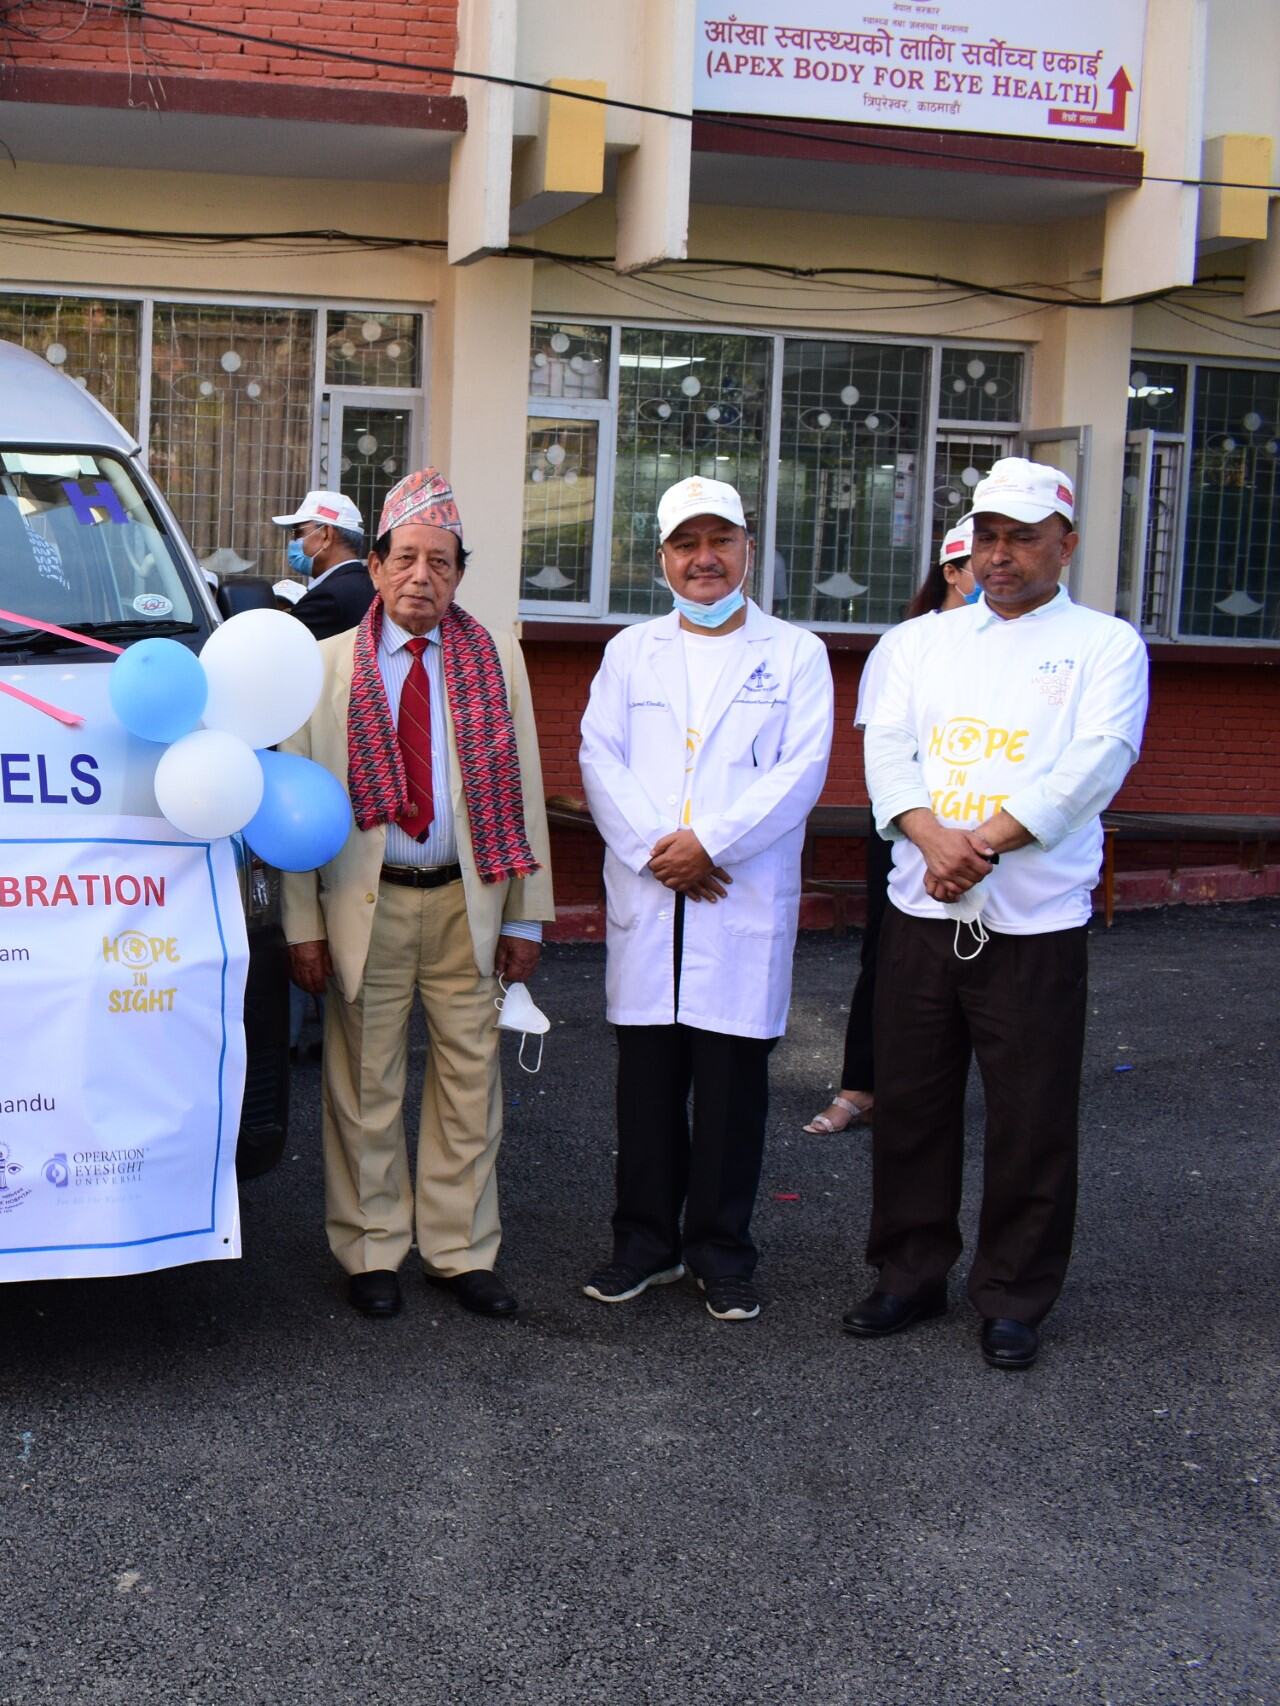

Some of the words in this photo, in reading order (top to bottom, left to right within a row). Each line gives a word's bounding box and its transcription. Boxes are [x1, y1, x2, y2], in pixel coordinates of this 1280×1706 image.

[705, 14, 768, 46] आँखा
[774, 27, 894, 57] स्वास्थ्यको
[900, 33, 955, 63] लागि
[961, 38, 1037, 70] सर्वोच्च
[1043, 49, 1103, 80] एकाई
[706, 50, 784, 79] (APEX
[793, 57, 864, 85] BODY
[873, 66, 925, 90] FOR
[934, 70, 982, 94] EYE
[992, 75, 1098, 111] HEALTH)
[946, 769, 967, 787] IN
[133, 972, 148, 987] IN
[108, 988, 178, 1013] SIGHT
[73, 1148, 145, 1164] OPERATION
[75, 1160, 145, 1177] EYESIGHT
